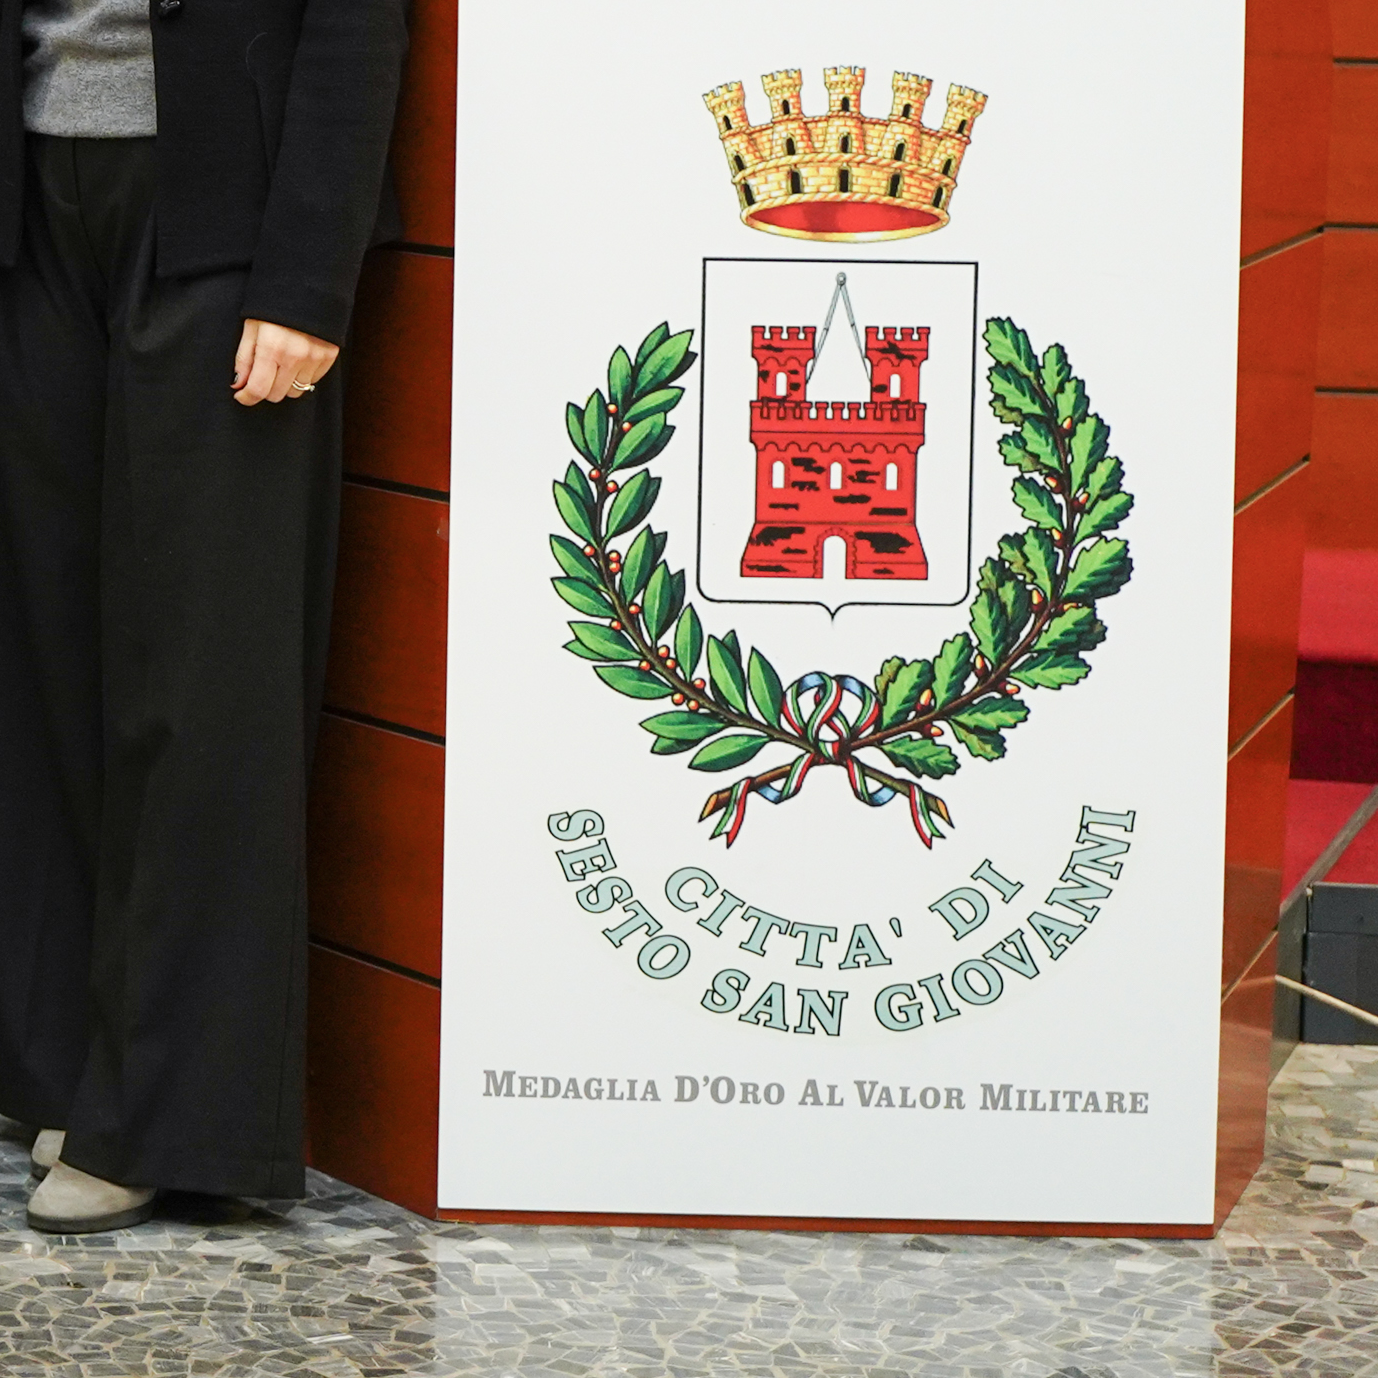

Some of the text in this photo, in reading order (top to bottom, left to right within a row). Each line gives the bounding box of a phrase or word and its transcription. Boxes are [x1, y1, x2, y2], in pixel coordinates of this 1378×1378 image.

[547, 805, 1137, 1037] SESTO SAN GIOVANNI
[665, 858, 1024, 970] CITTA' DI
